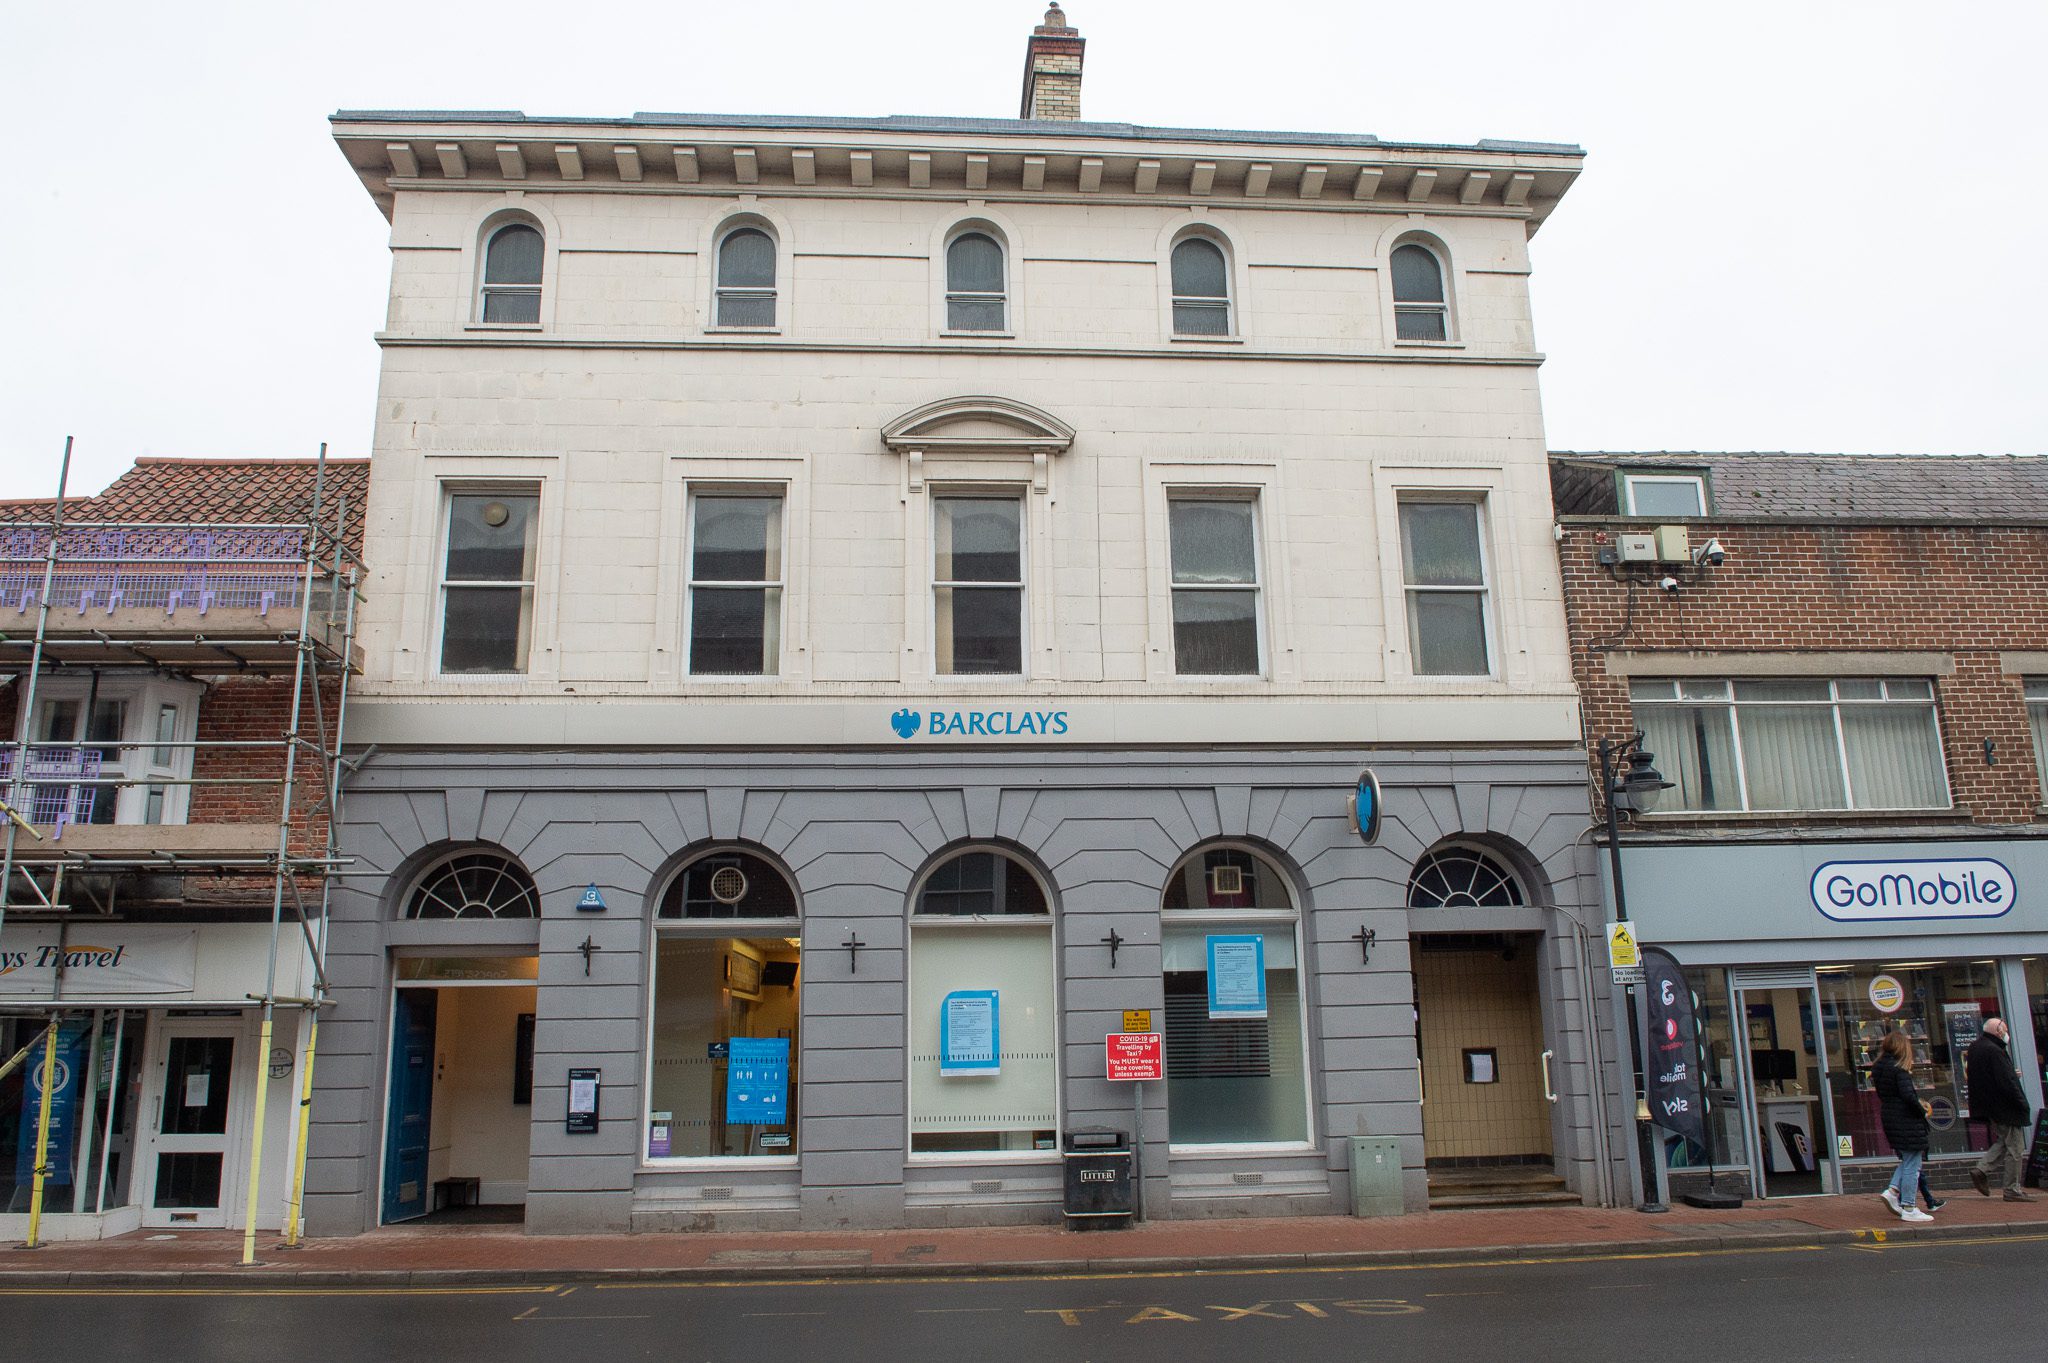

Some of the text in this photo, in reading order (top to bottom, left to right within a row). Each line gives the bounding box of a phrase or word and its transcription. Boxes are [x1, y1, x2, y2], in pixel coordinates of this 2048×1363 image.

[929, 711, 1068, 735] BARCLAYS
[1826, 871, 2003, 907] GoMobile
[34, 944, 125, 968] Travel
[1083, 1172, 1113, 1180] LITTER
[1024, 1299, 1425, 1326] TAXIS
